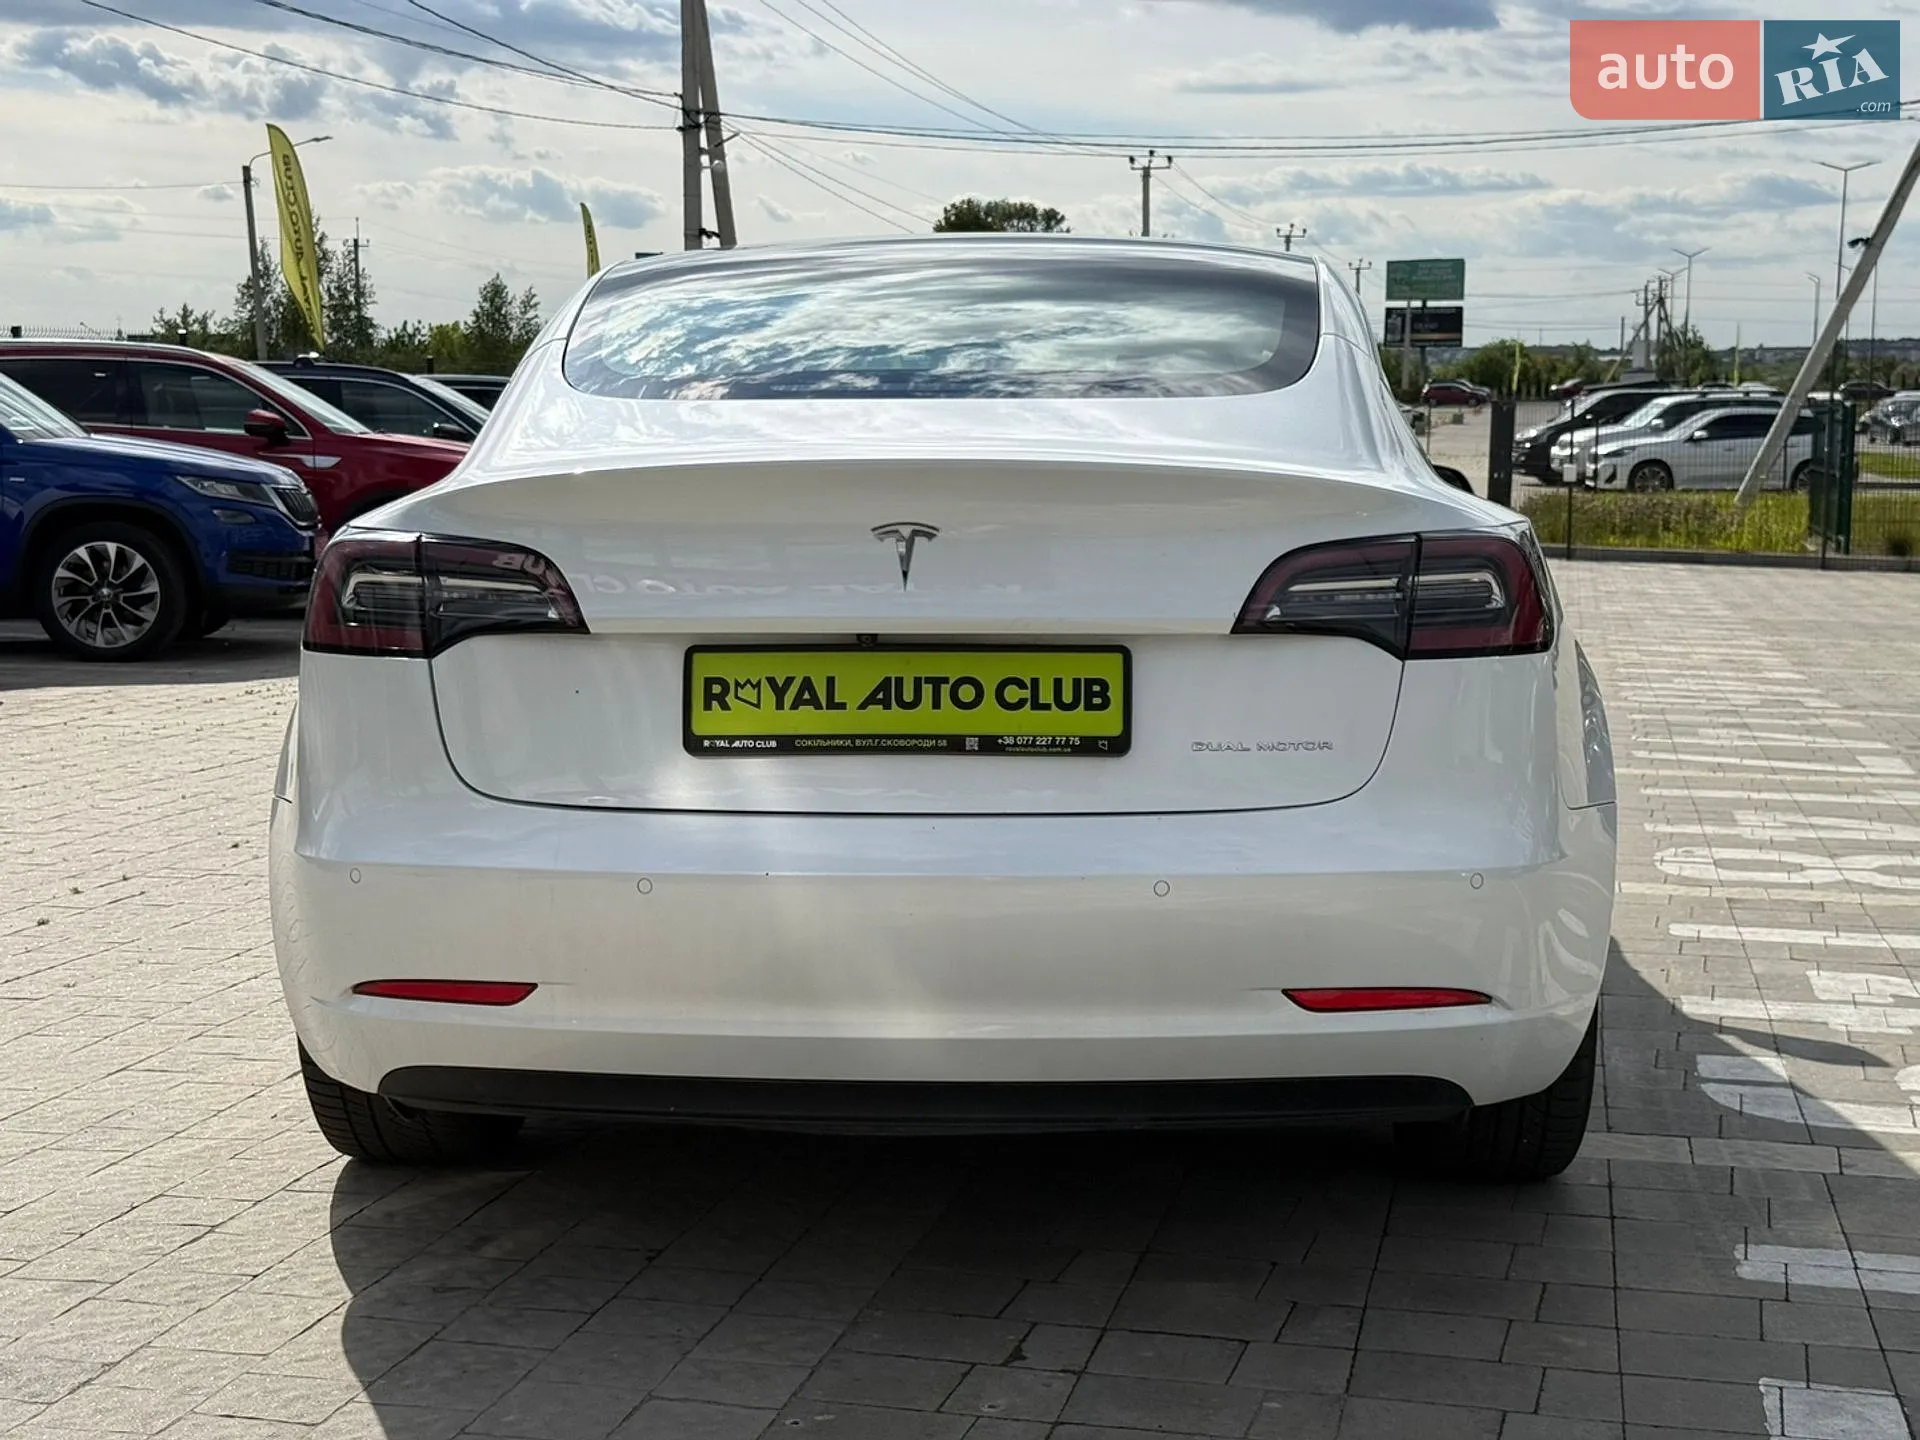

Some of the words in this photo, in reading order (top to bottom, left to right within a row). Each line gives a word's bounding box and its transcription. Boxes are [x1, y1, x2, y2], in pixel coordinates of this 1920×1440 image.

[855, 675, 985, 711] AUTO
[994, 676, 1112, 712] CLUB
[731, 739, 754, 748] AUTO
[755, 739, 777, 748] CLUB
[997, 736, 1015, 745] +38
[1016, 736, 1034, 745] 077
[1035, 736, 1053, 745] 227
[1055, 736, 1067, 745] 77
[1068, 736, 1081, 745] 75
[1192, 741, 1251, 752] DUAL
[1256, 741, 1334, 752] MOTOR
